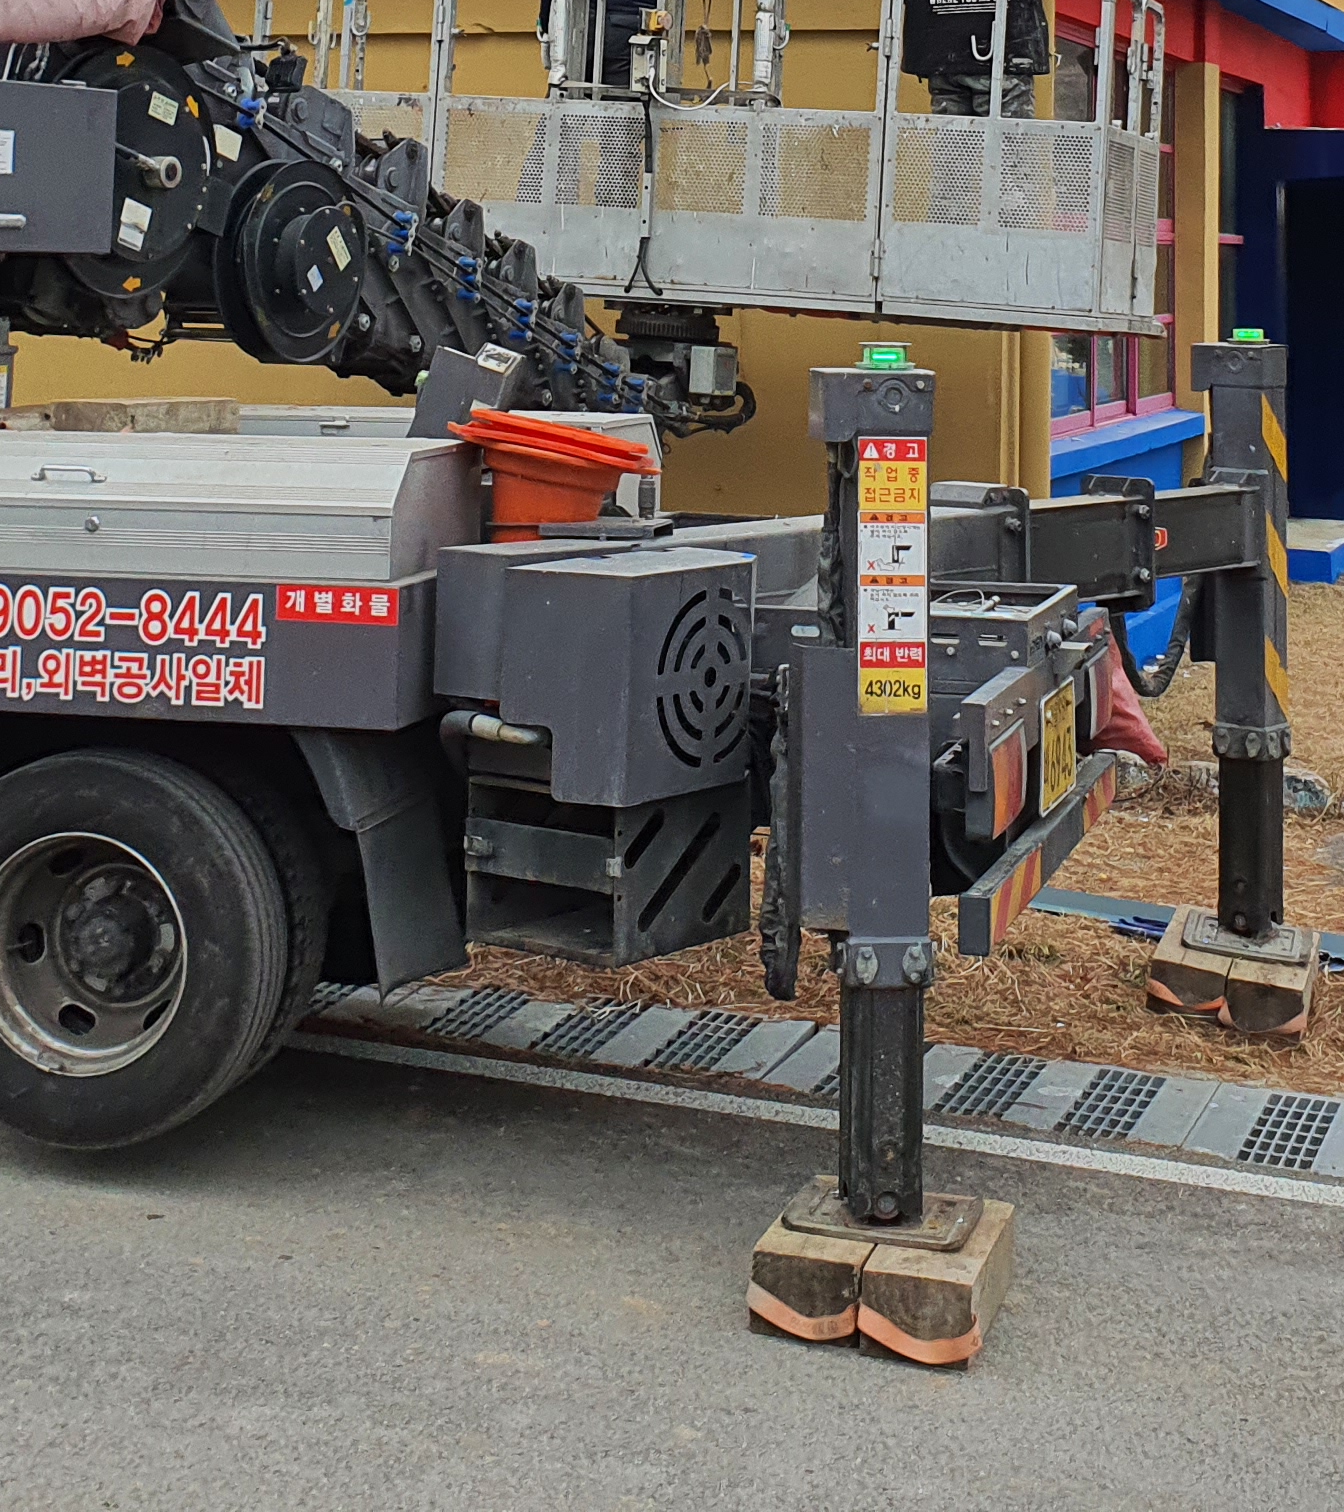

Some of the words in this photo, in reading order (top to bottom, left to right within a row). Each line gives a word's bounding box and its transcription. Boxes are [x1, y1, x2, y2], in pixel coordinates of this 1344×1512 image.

[864, 487, 920, 504] 접근금지
[863, 646, 890, 663] 최대
[896, 646, 923, 663] 반력
[864, 679, 921, 700] 4302kg
